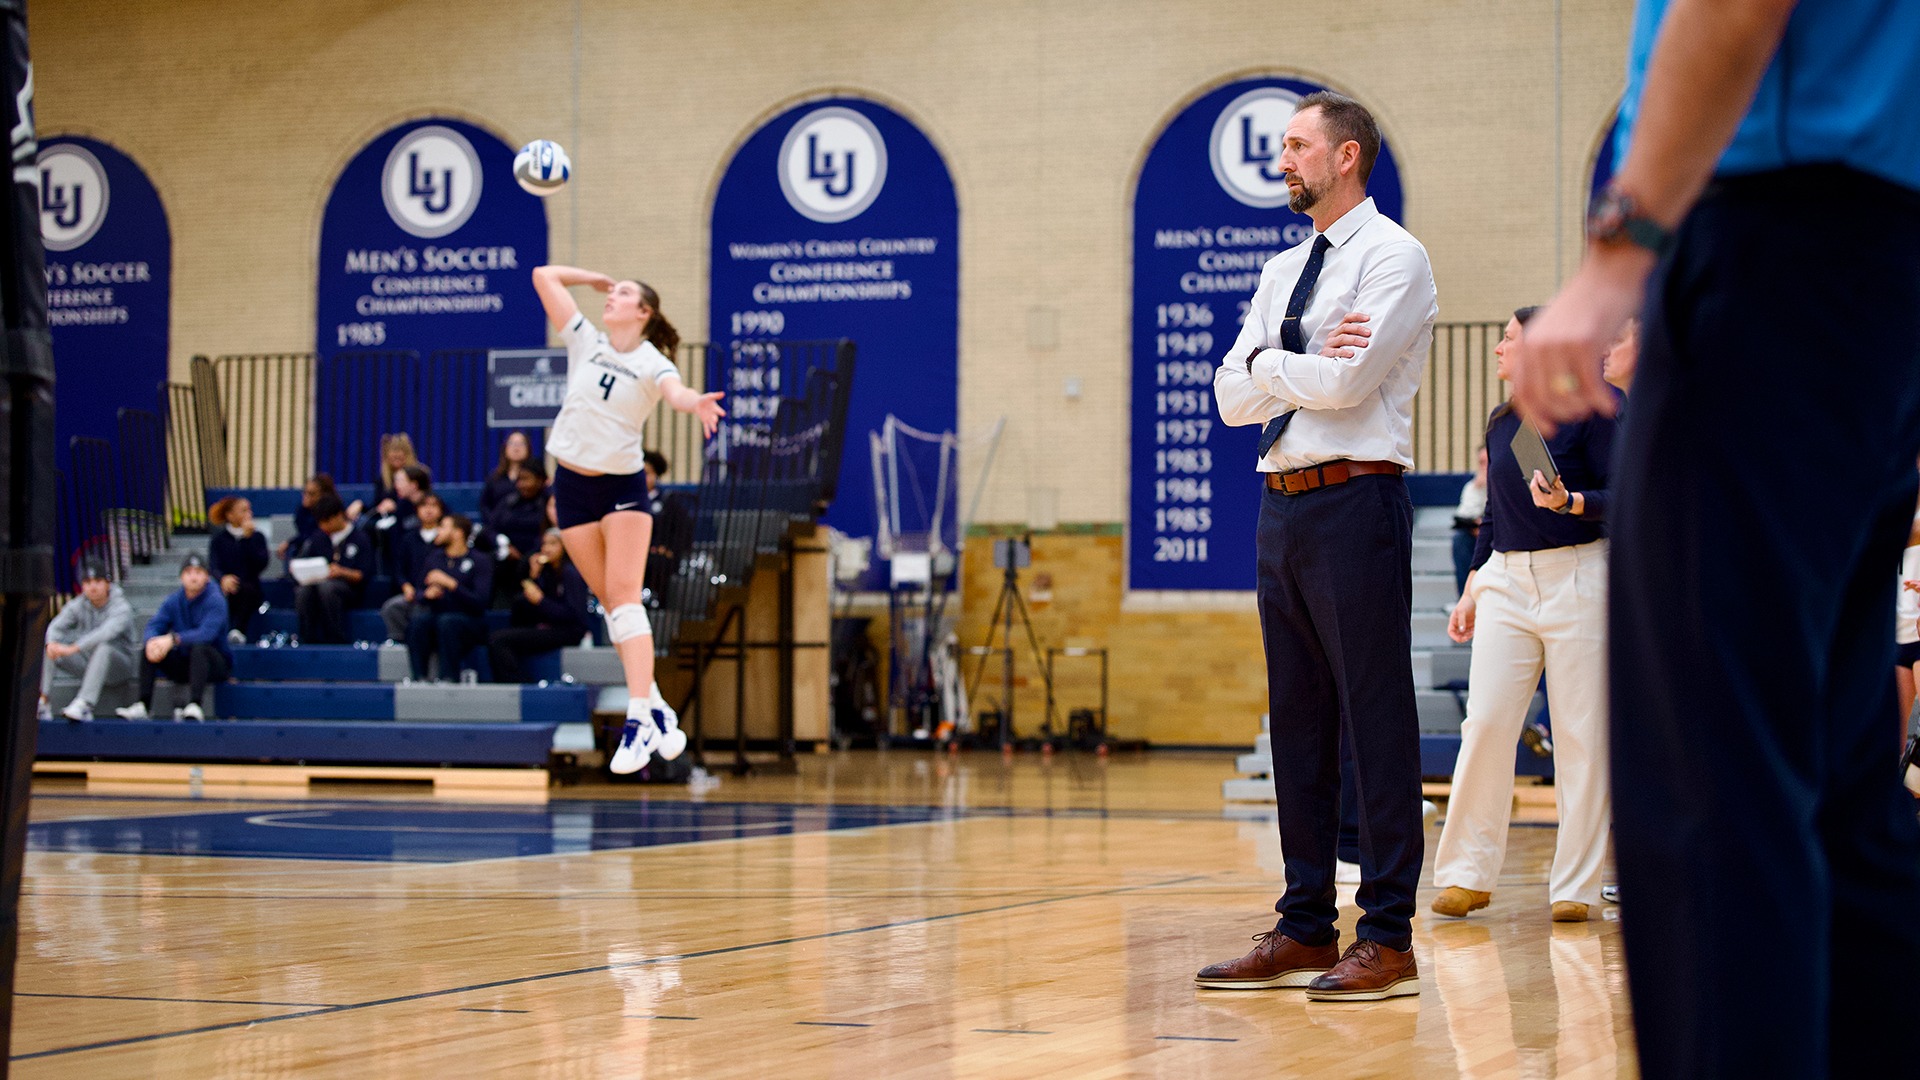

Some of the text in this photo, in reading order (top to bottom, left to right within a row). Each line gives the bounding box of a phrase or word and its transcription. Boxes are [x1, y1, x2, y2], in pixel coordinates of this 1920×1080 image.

[804, 239, 857, 259] CROSS
[857, 237, 938, 257] COUNTRY
[1154, 226, 1214, 249] MEN'S
[1215, 225, 1281, 248] CROSS
[71, 261, 151, 285] SOCCER
[345, 246, 519, 274] MEN'S SOCCER
[769, 261, 895, 283] CONFERENCE
[372, 274, 488, 296] CONFERENCE
[753, 280, 912, 304] CHAMPIONSHIPS
[356, 293, 504, 316] CHAMPIONSHIPS
[1156, 302, 1214, 328] 1936
[337, 321, 386, 346] 1985
[731, 310, 785, 335] 1990
[1156, 331, 1213, 357] 1949
[1156, 360, 1213, 386] 1950
[599, 372, 616, 401] 4
[1156, 390, 1210, 416] 1951
[1156, 419, 1212, 445] 1957
[1156, 448, 1212, 474] 1983
[1156, 477, 1212, 503] 1984
[1156, 507, 1212, 533] 1985
[1153, 536, 1208, 562] 2011
